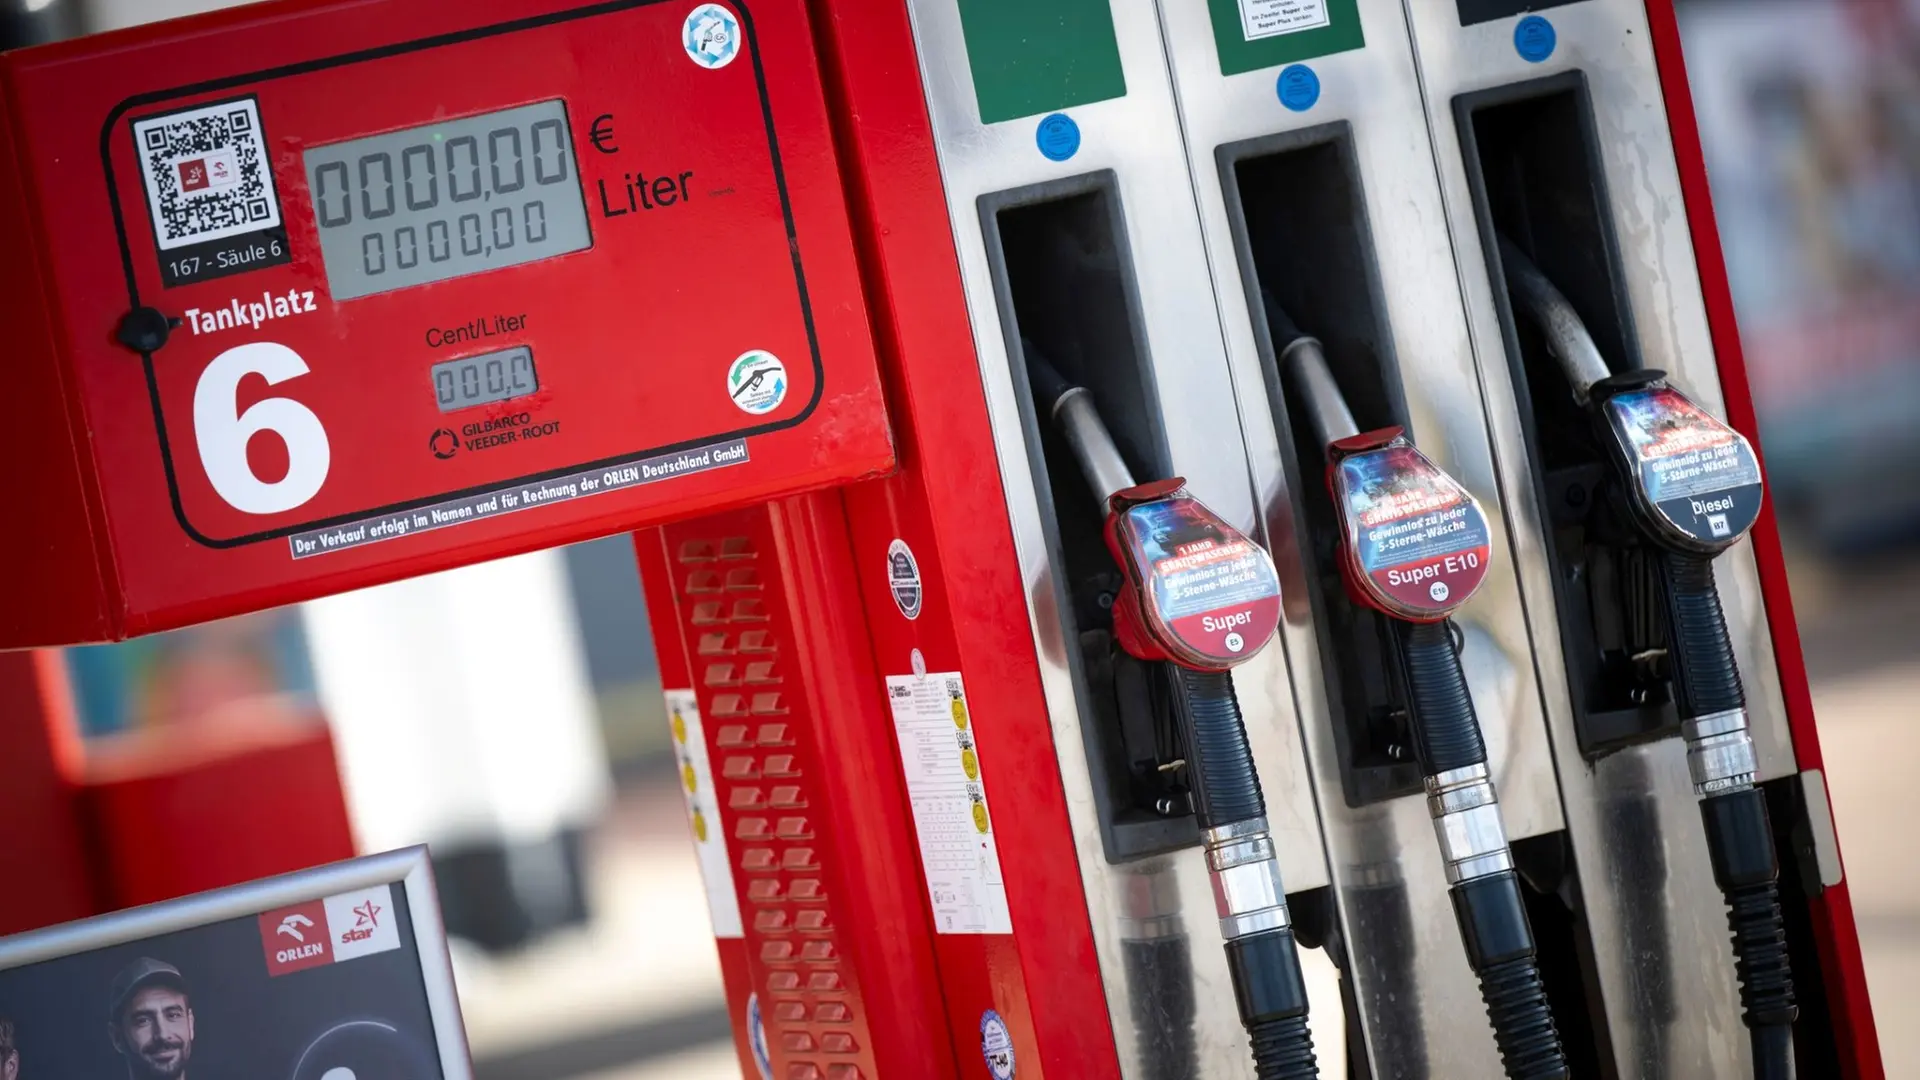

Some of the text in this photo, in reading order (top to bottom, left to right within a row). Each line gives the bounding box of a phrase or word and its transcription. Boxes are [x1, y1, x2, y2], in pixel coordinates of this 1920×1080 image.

[1258, 21, 1276, 29] Super
[1282, 7, 1301, 15] Super
[588, 113, 620, 154] €
[314, 117, 569, 229] 0000,00
[597, 170, 693, 218] Liter
[362, 200, 548, 276] 0000,00
[169, 256, 200, 278] 167
[216, 244, 266, 268] Säule
[270, 239, 282, 257] 6
[185, 288, 317, 336] Tankplatz
[425, 313, 527, 348] Cent/Liter
[193, 341, 331, 515] 6
[462, 412, 531, 437] GILBARCO
[465, 421, 561, 452] VEEDER-ROOT
[1652, 444, 1739, 473] Gewinnlos zu jeder
[1660, 457, 1739, 484] 5-Sterne-Wäsche
[295, 444, 746, 553] Der Verkauf erfolgt im Namen und für Rechnung der ORLEN Deutschland GmbH
[1691, 495, 1735, 516] Diesel
[1368, 507, 1467, 542] Gewinnlos zu jeder
[1378, 520, 1467, 553] 5-Sterne-Wäsche
[1713, 520, 1726, 531] B7
[1187, 540, 1214, 553] JAHR
[1217, 564, 1230, 576] zu
[1230, 557, 1257, 573] jeder
[1387, 552, 1479, 586] Super E10
[1172, 570, 1257, 600] 5-Sterne-Wäsche
[1432, 586, 1447, 596] E10
[1201, 609, 1253, 633] Super
[1229, 637, 1240, 646] E5
[341, 927, 374, 944] star
[276, 942, 324, 963] ORLEN
